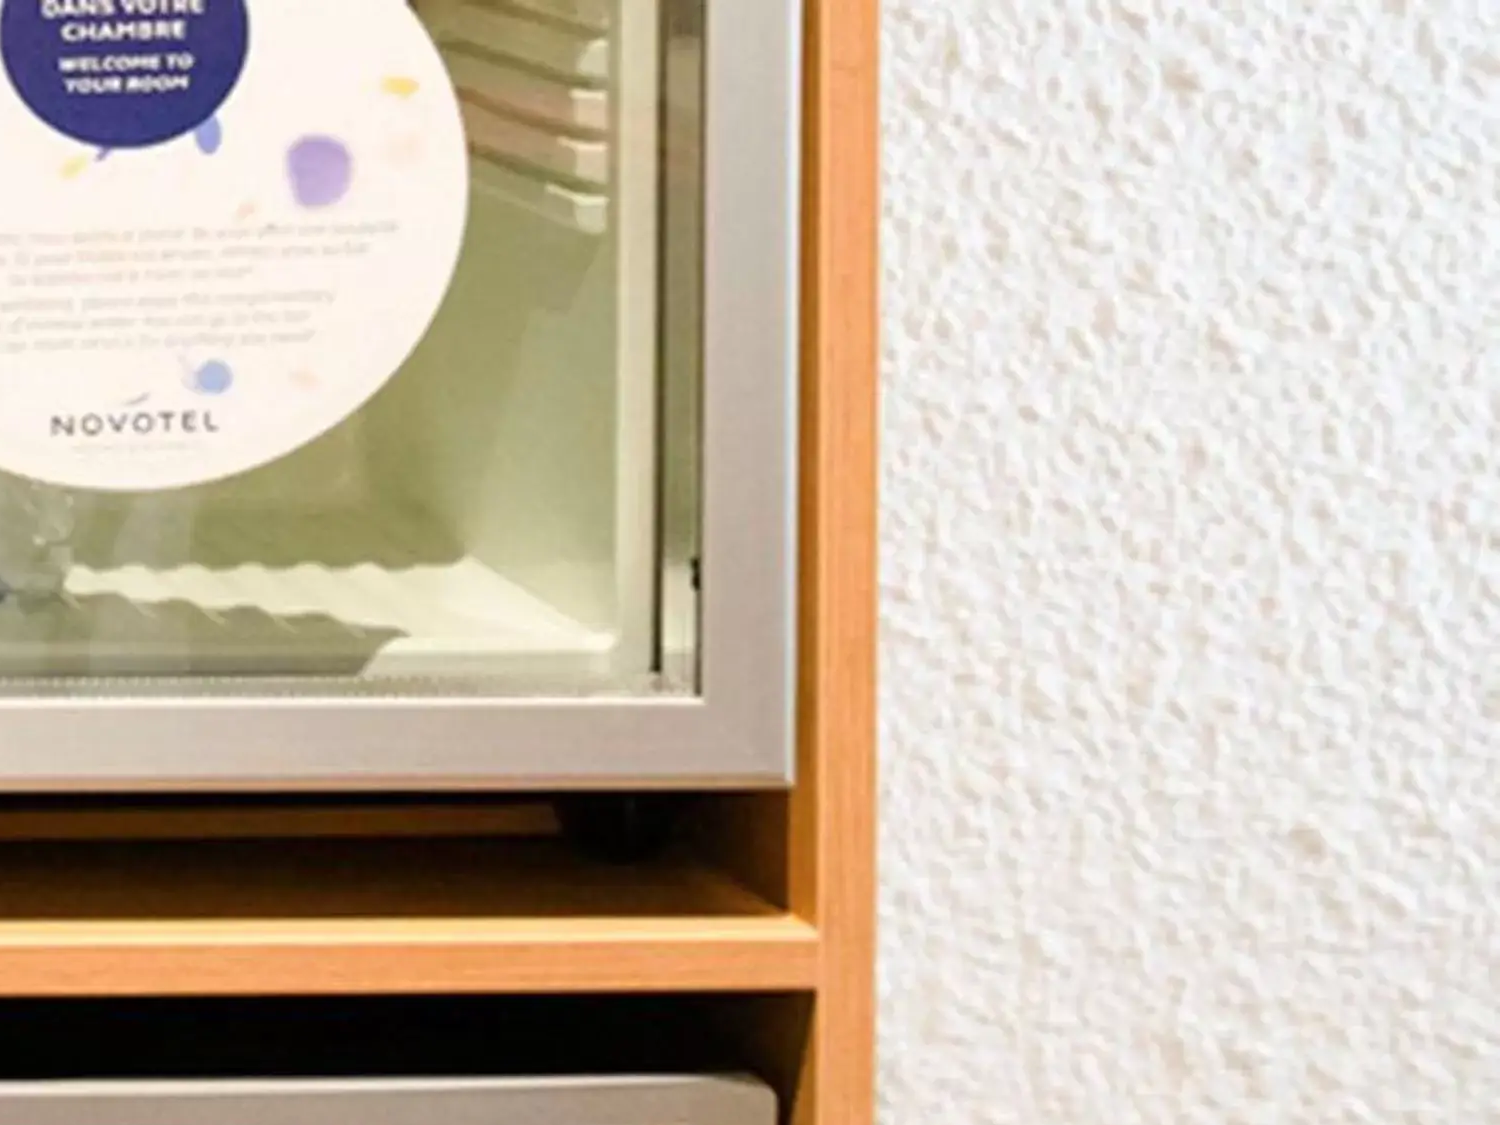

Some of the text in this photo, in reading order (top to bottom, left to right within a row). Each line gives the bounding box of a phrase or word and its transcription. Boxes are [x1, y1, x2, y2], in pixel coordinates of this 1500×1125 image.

[41, 0, 205, 19] DANS VOTRE
[60, 20, 187, 42] CHAMBRE
[58, 52, 196, 73] WELCOME TO
[63, 74, 191, 95] YOUR ROOM
[49, 408, 221, 437] NOVOTEL
